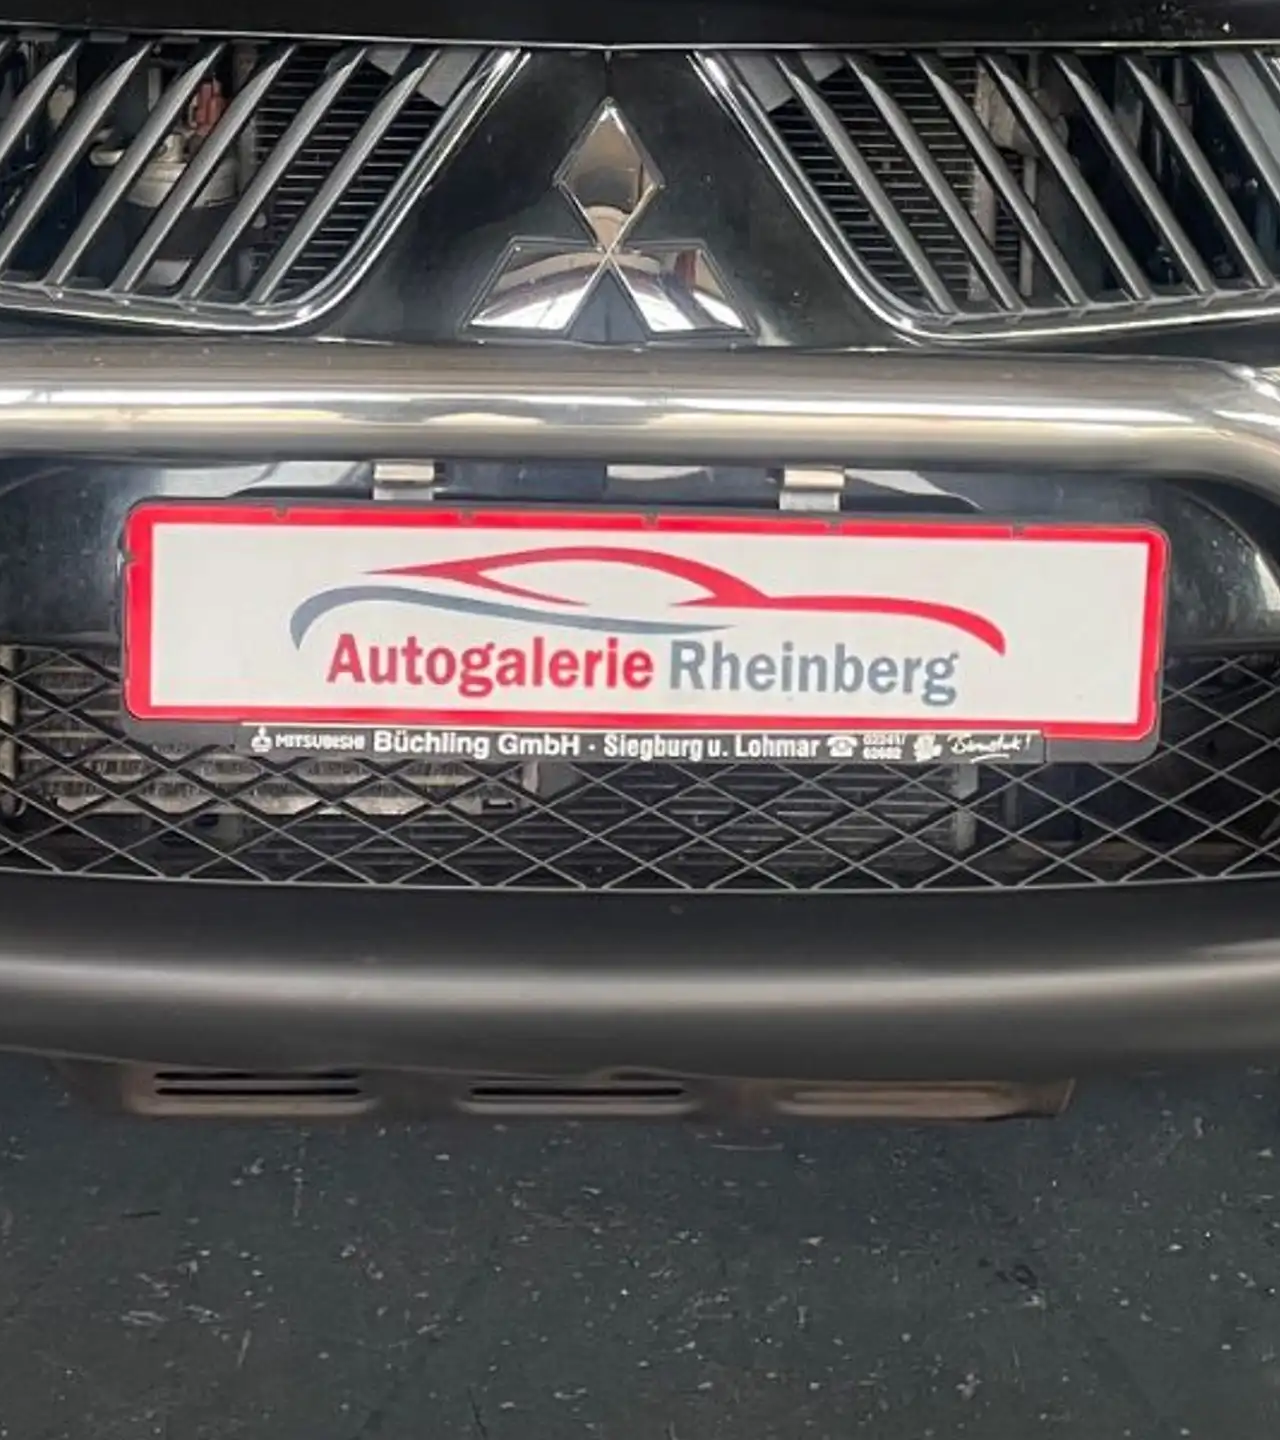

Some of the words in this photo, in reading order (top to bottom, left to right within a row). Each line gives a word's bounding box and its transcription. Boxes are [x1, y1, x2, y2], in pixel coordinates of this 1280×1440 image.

[326, 632, 654, 698] Autogalerie
[669, 638, 960, 707] Rheinberg
[373, 730, 490, 758] Büchling
[497, 733, 581, 757] GmbH
[604, 733, 703, 761] Siegburg
[706, 741, 729, 758] u.
[735, 734, 821, 759] Lohmar
